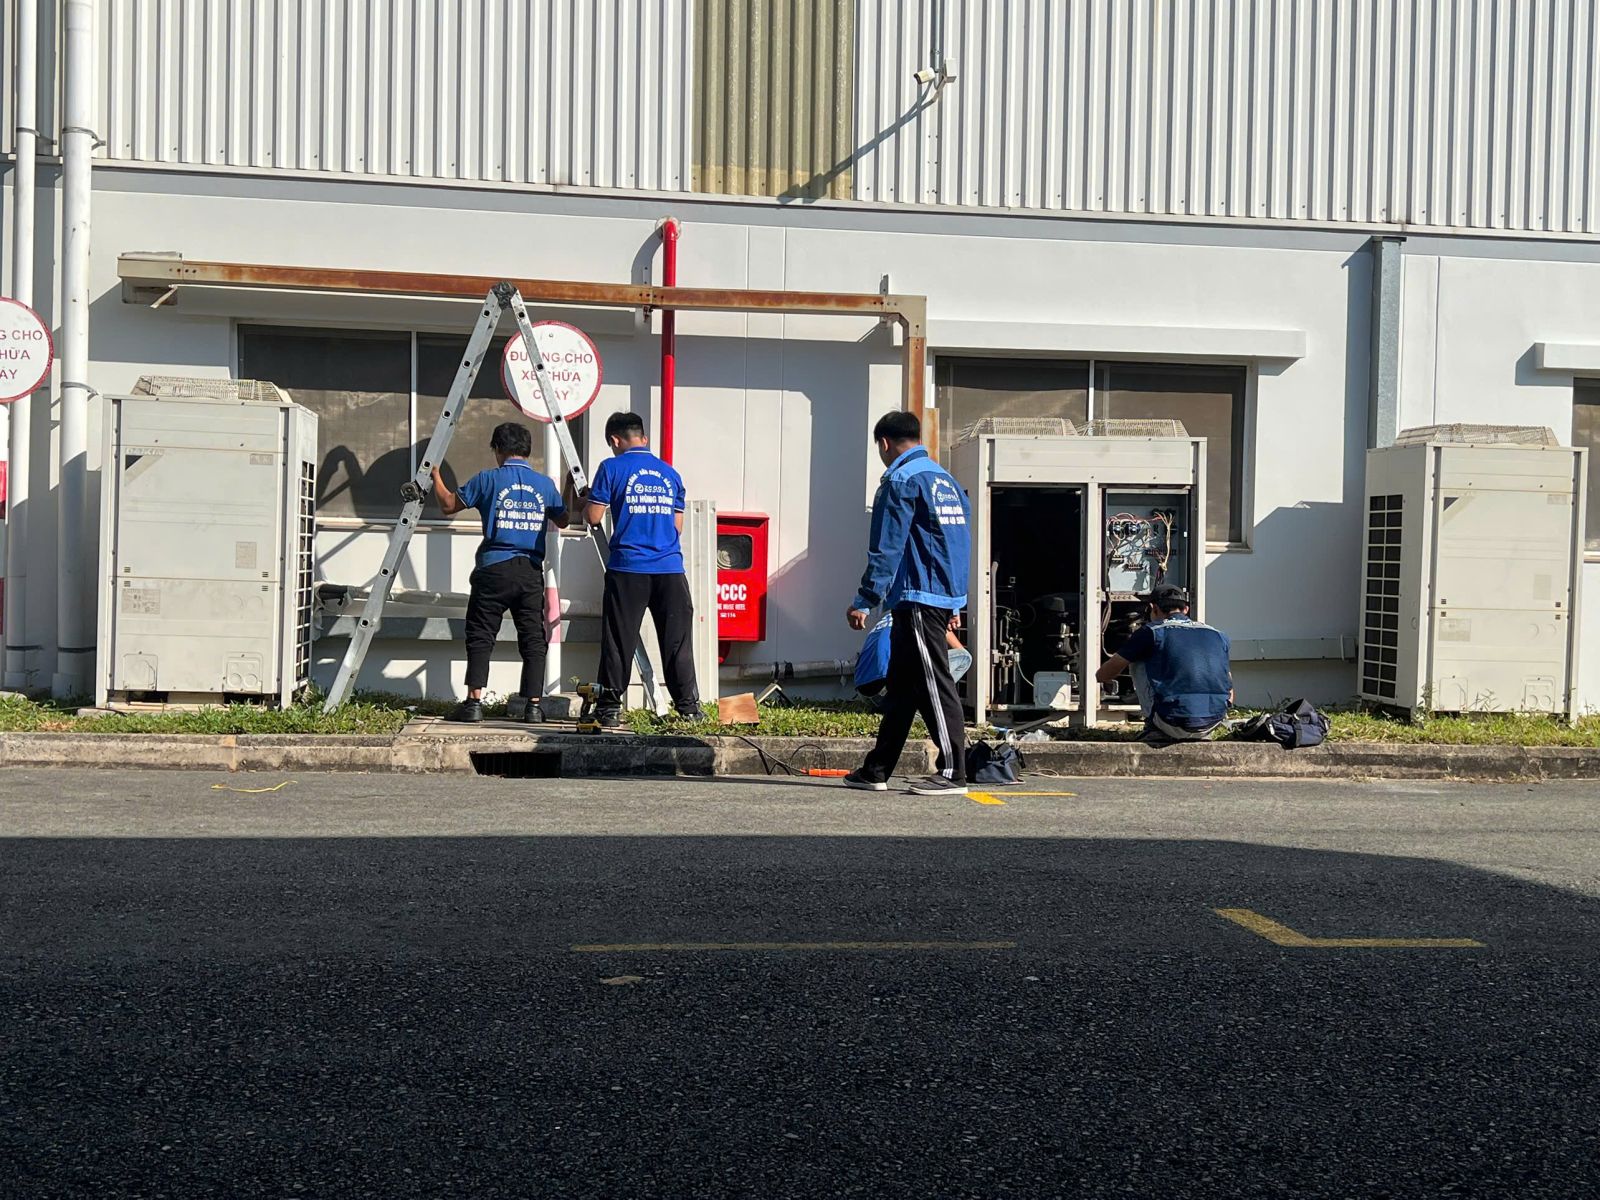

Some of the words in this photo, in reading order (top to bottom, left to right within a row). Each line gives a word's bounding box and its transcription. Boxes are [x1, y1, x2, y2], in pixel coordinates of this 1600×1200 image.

[12, 330, 43, 341] CHO
[0, 347, 30, 360] HỮA
[564, 352, 593, 364] CHO
[545, 369, 581, 382] HỮA
